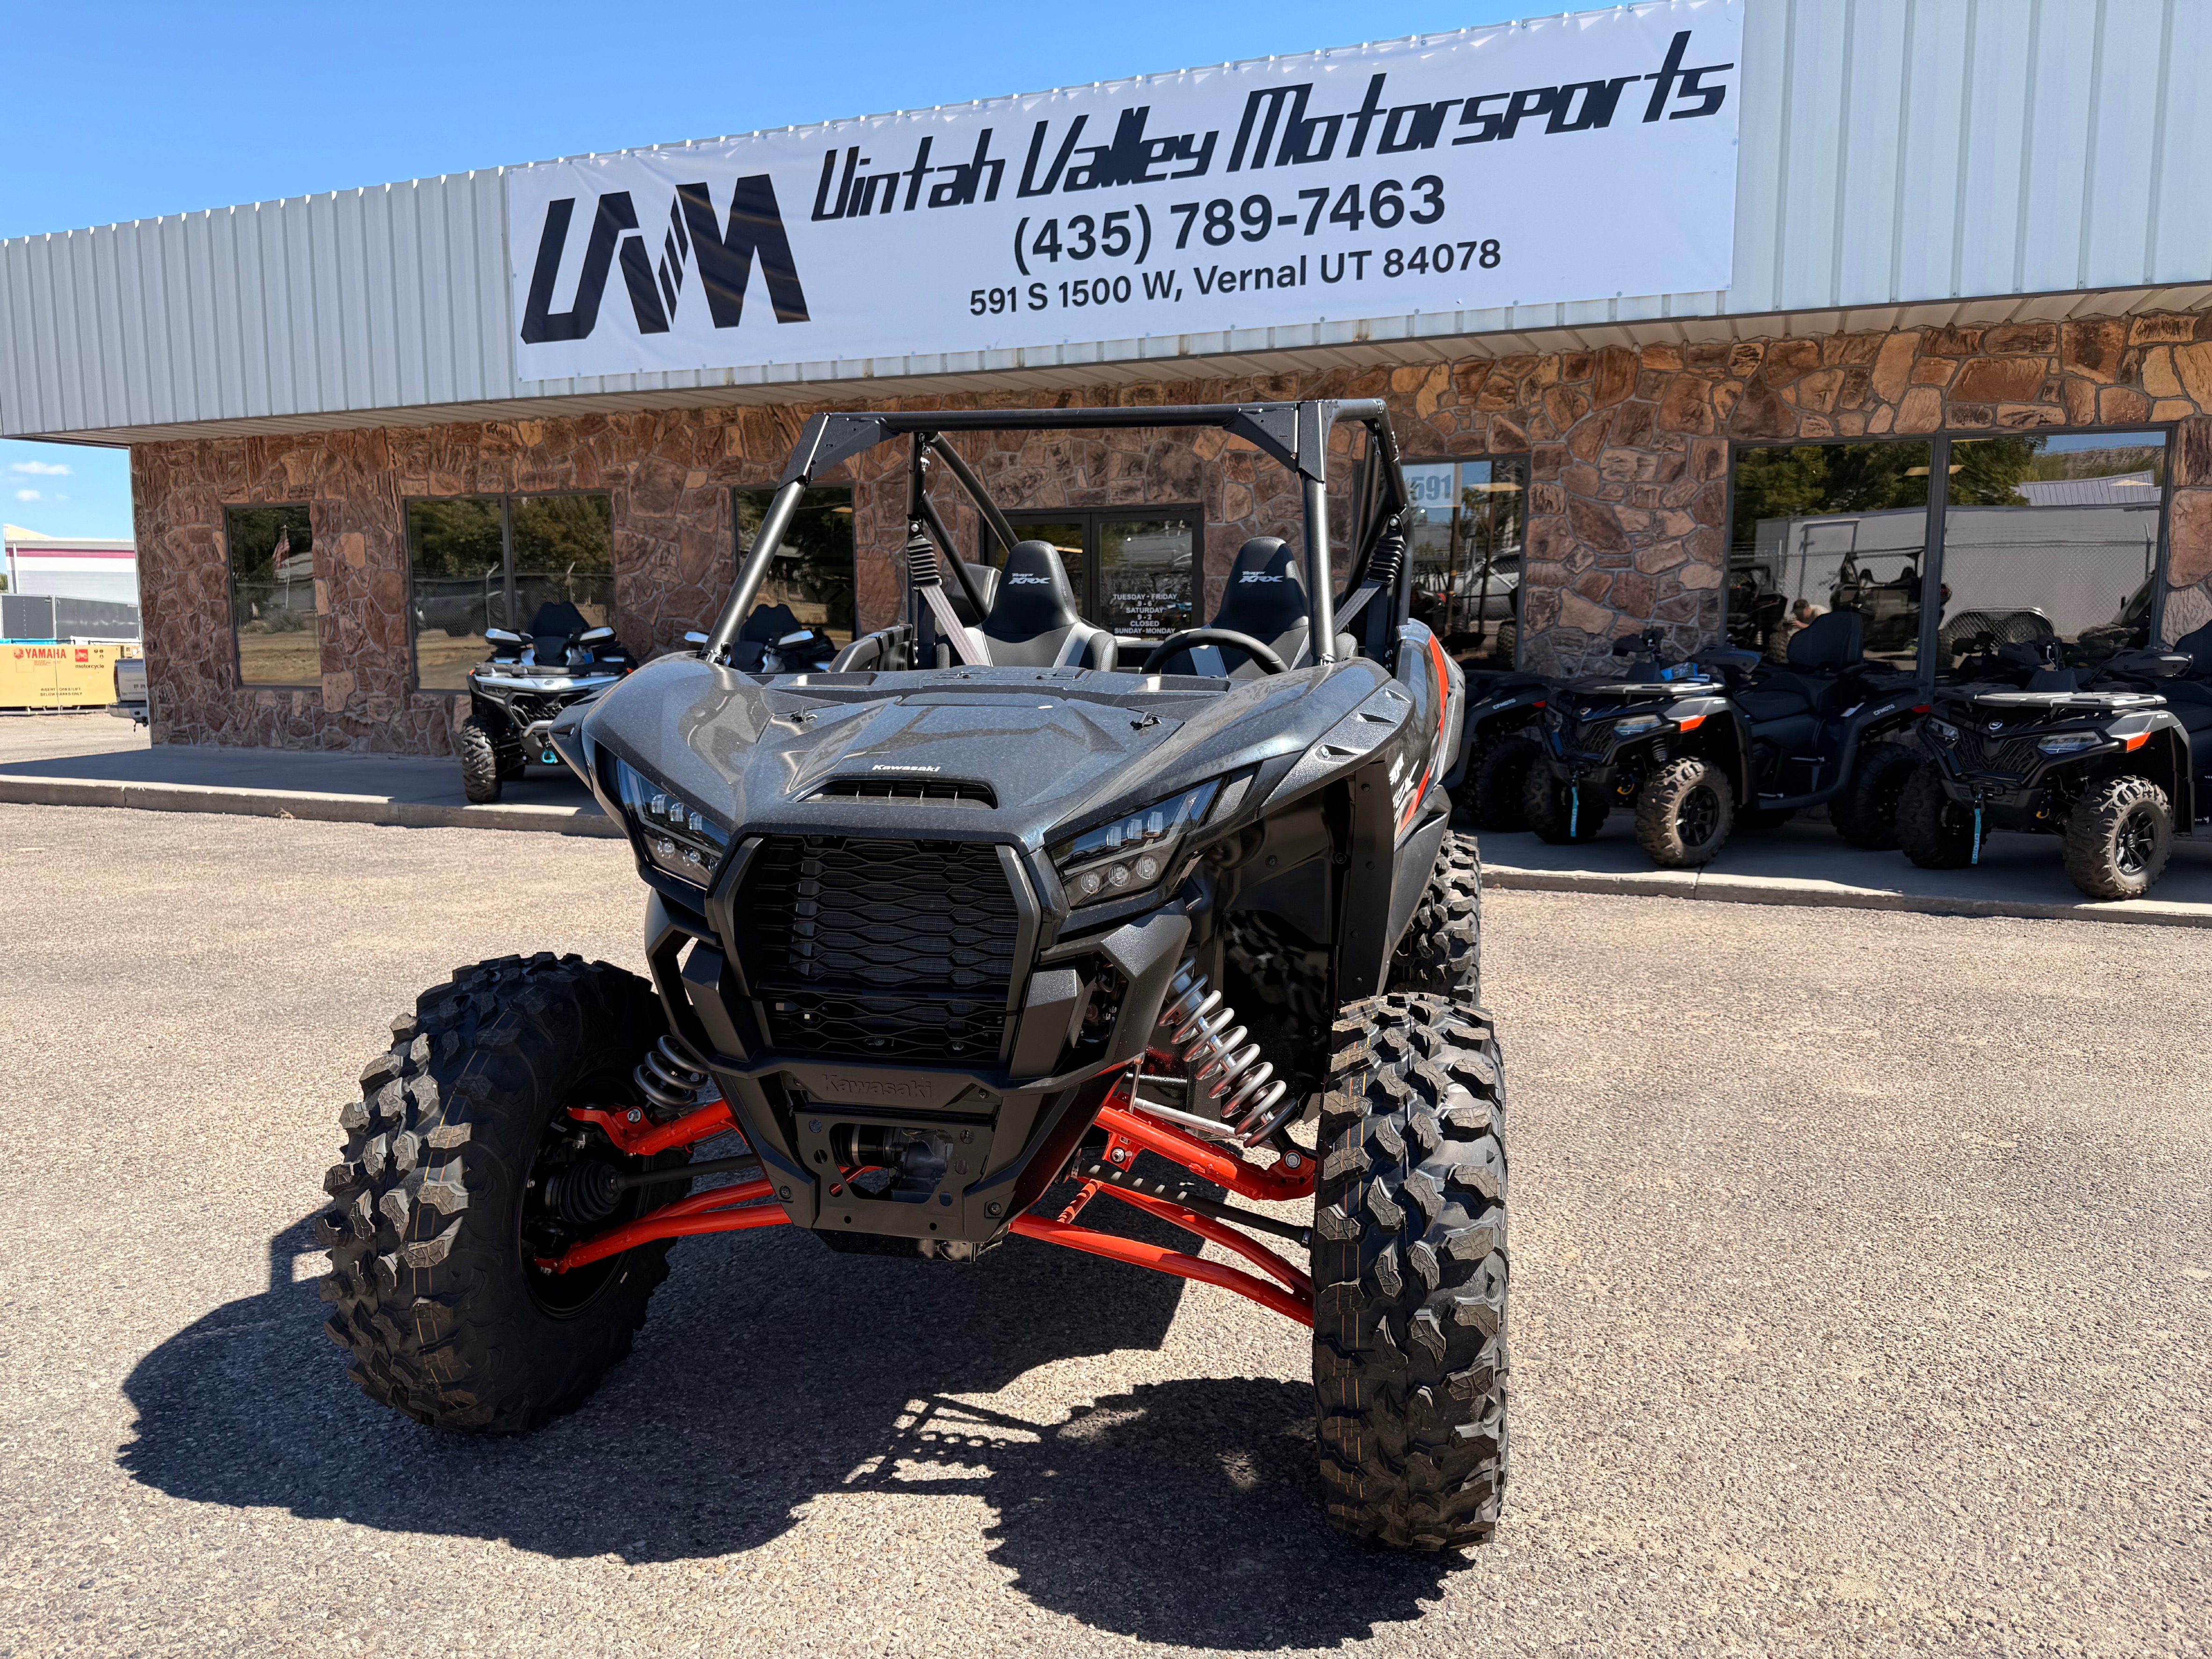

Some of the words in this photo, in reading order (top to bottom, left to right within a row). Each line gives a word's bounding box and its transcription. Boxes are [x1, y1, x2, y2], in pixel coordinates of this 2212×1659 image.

[811, 128, 1005, 221] Uintah
[1016, 106, 1219, 198] Valley
[1226, 30, 1733, 172] Motorsports
[1015, 199, 1151, 276] (435)
[1171, 175, 1444, 249] 789-7463
[971, 287, 1016, 315] 591
[1028, 283, 1048, 311] S
[1059, 276, 1131, 307] 1500
[1142, 270, 1183, 302] W,
[1193, 255, 1306, 295] Vernal
[1320, 250, 1372, 284] UT
[1383, 240, 1501, 278] 84078
[1411, 475, 1451, 501] 591
[25, 648, 66, 659] YAMAHA
[821, 1074, 932, 1099] Kawasaki
